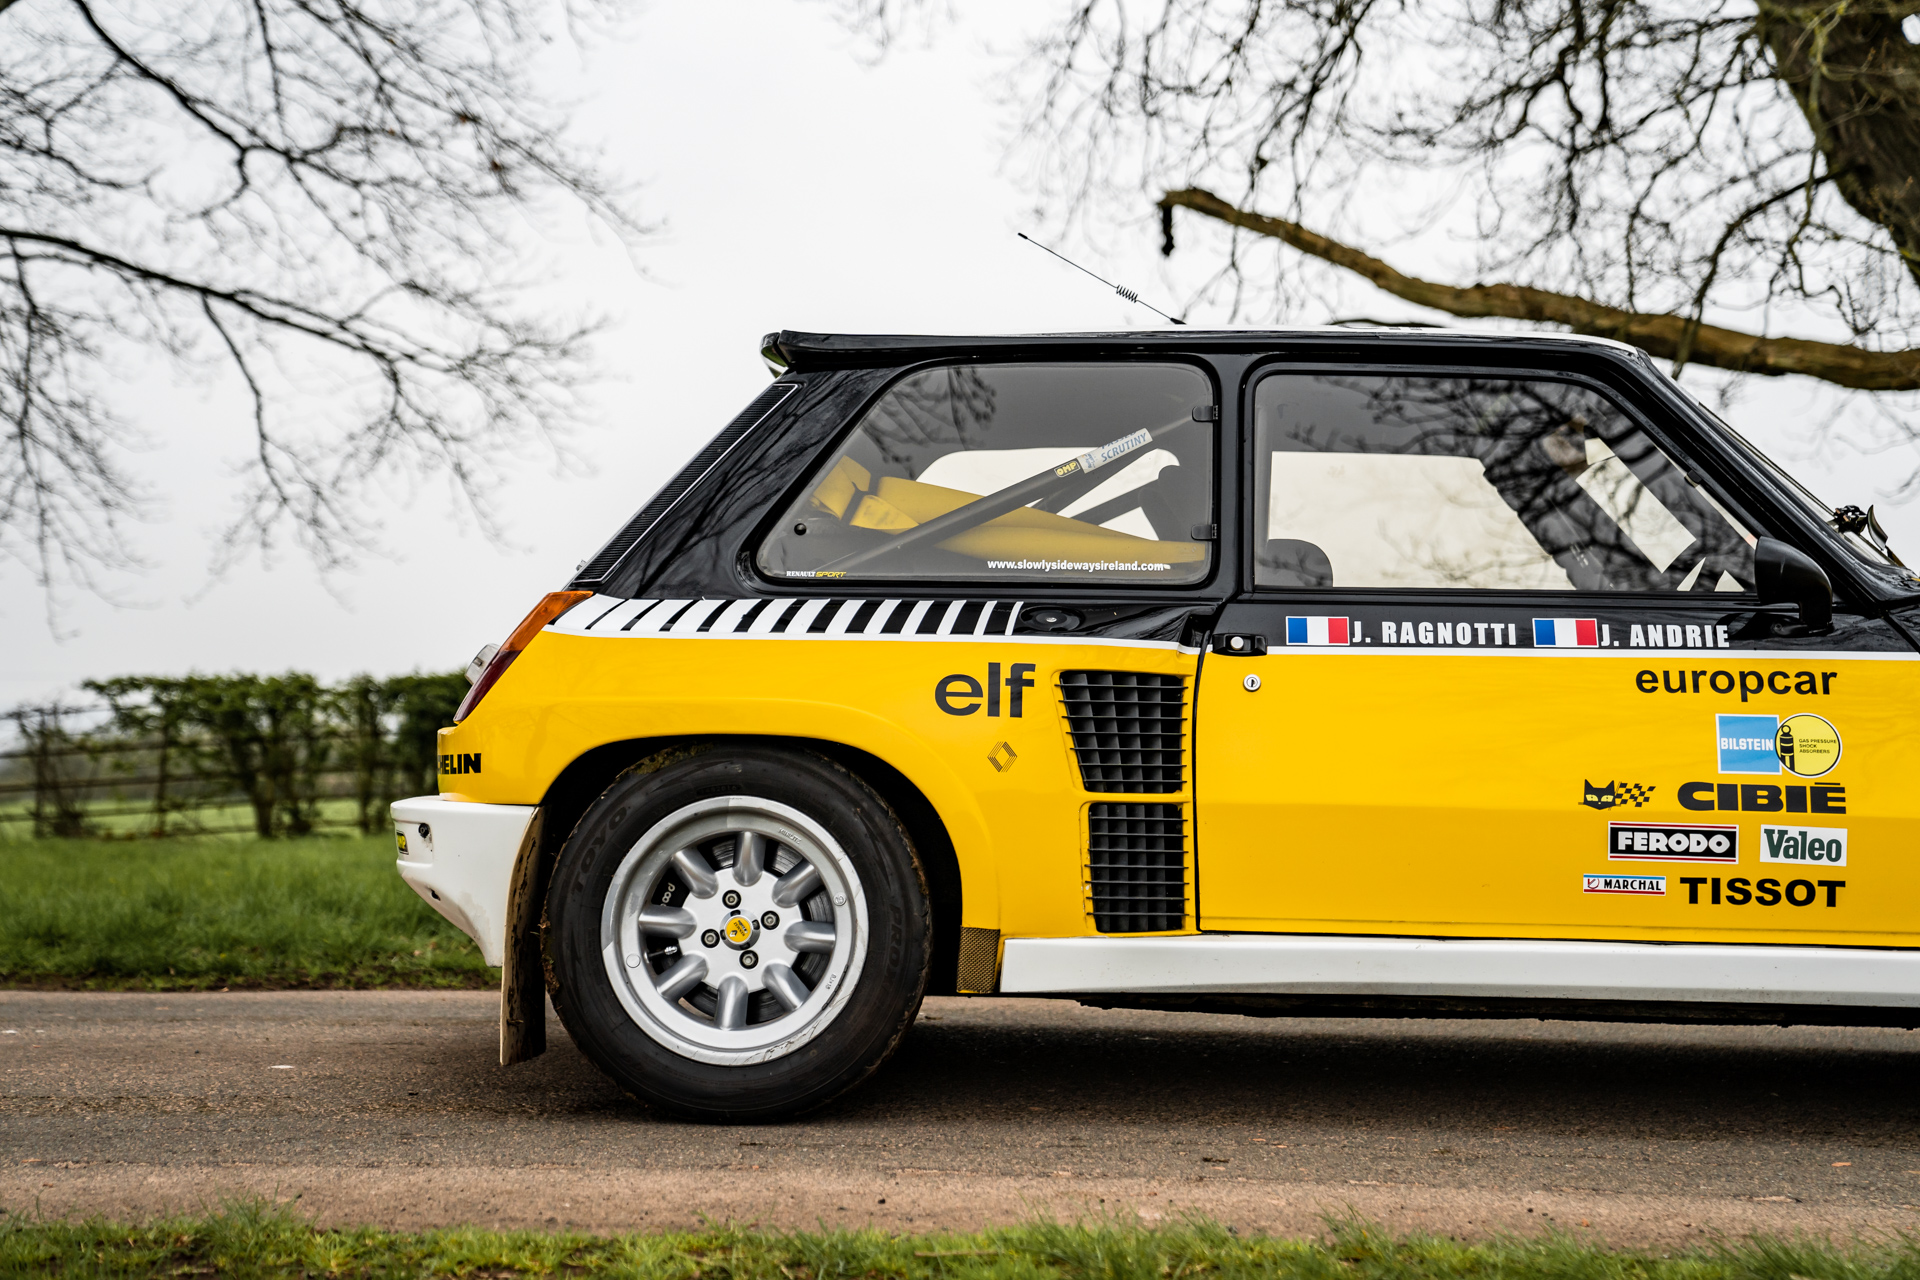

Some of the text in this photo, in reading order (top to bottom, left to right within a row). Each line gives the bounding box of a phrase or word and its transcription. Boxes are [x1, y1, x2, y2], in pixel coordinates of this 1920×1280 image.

[1101, 432, 1147, 463] SCRUTINY
[1056, 461, 1077, 476] OMP
[987, 559, 1164, 572] www.slowlysidewaysireland.com
[1352, 621, 1517, 645] J. RAGNOTTI
[1601, 624, 1730, 647] J. ANDRIE
[934, 662, 1036, 718] elf
[1635, 669, 1838, 703] europcar
[1720, 737, 1774, 751] BILSTEIN
[438, 753, 482, 775] HELIN
[1617, 830, 1731, 854] FERODO
[1763, 828, 1842, 863] Valeo
[1603, 878, 1662, 891] MARCHAL
[1680, 876, 1846, 908] TISSOT
